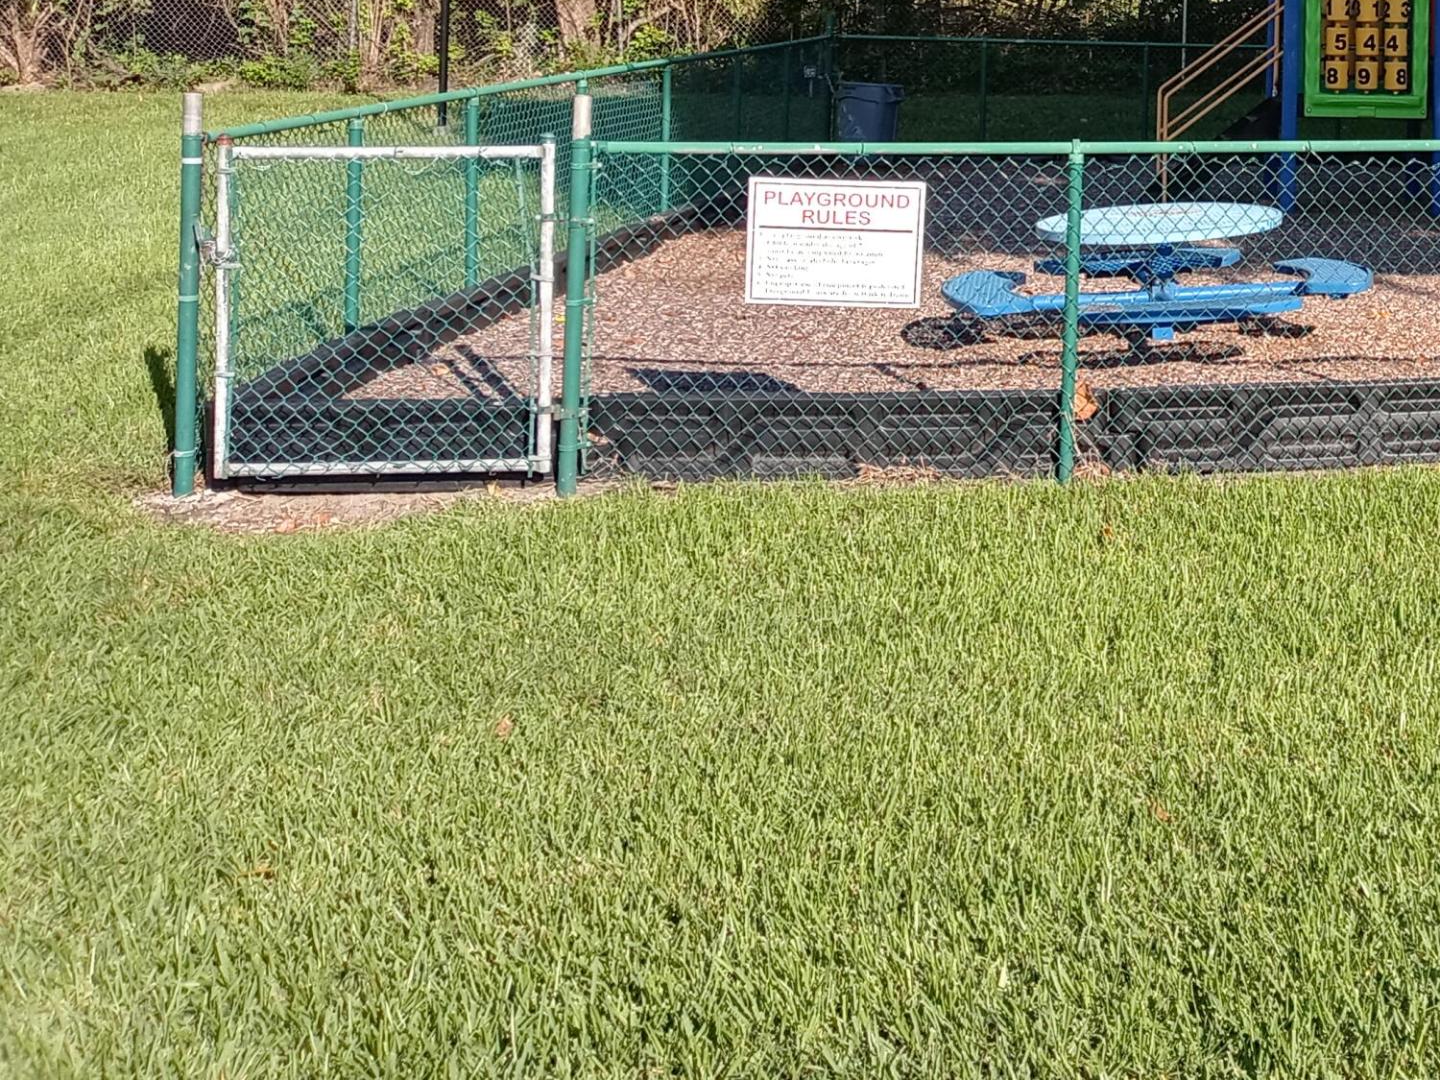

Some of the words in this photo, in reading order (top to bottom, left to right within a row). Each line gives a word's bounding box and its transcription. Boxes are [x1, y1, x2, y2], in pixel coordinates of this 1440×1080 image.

[1334, 34, 1347, 50] 5
[1363, 34, 1376, 51] 4
[1386, 35, 1398, 52] 4
[1327, 68, 1338, 84] 8
[1357, 68, 1370, 84] 9
[1396, 68, 1407, 85] 8
[764, 190, 910, 209] PLAYGROUND
[802, 209, 871, 226] RULES
